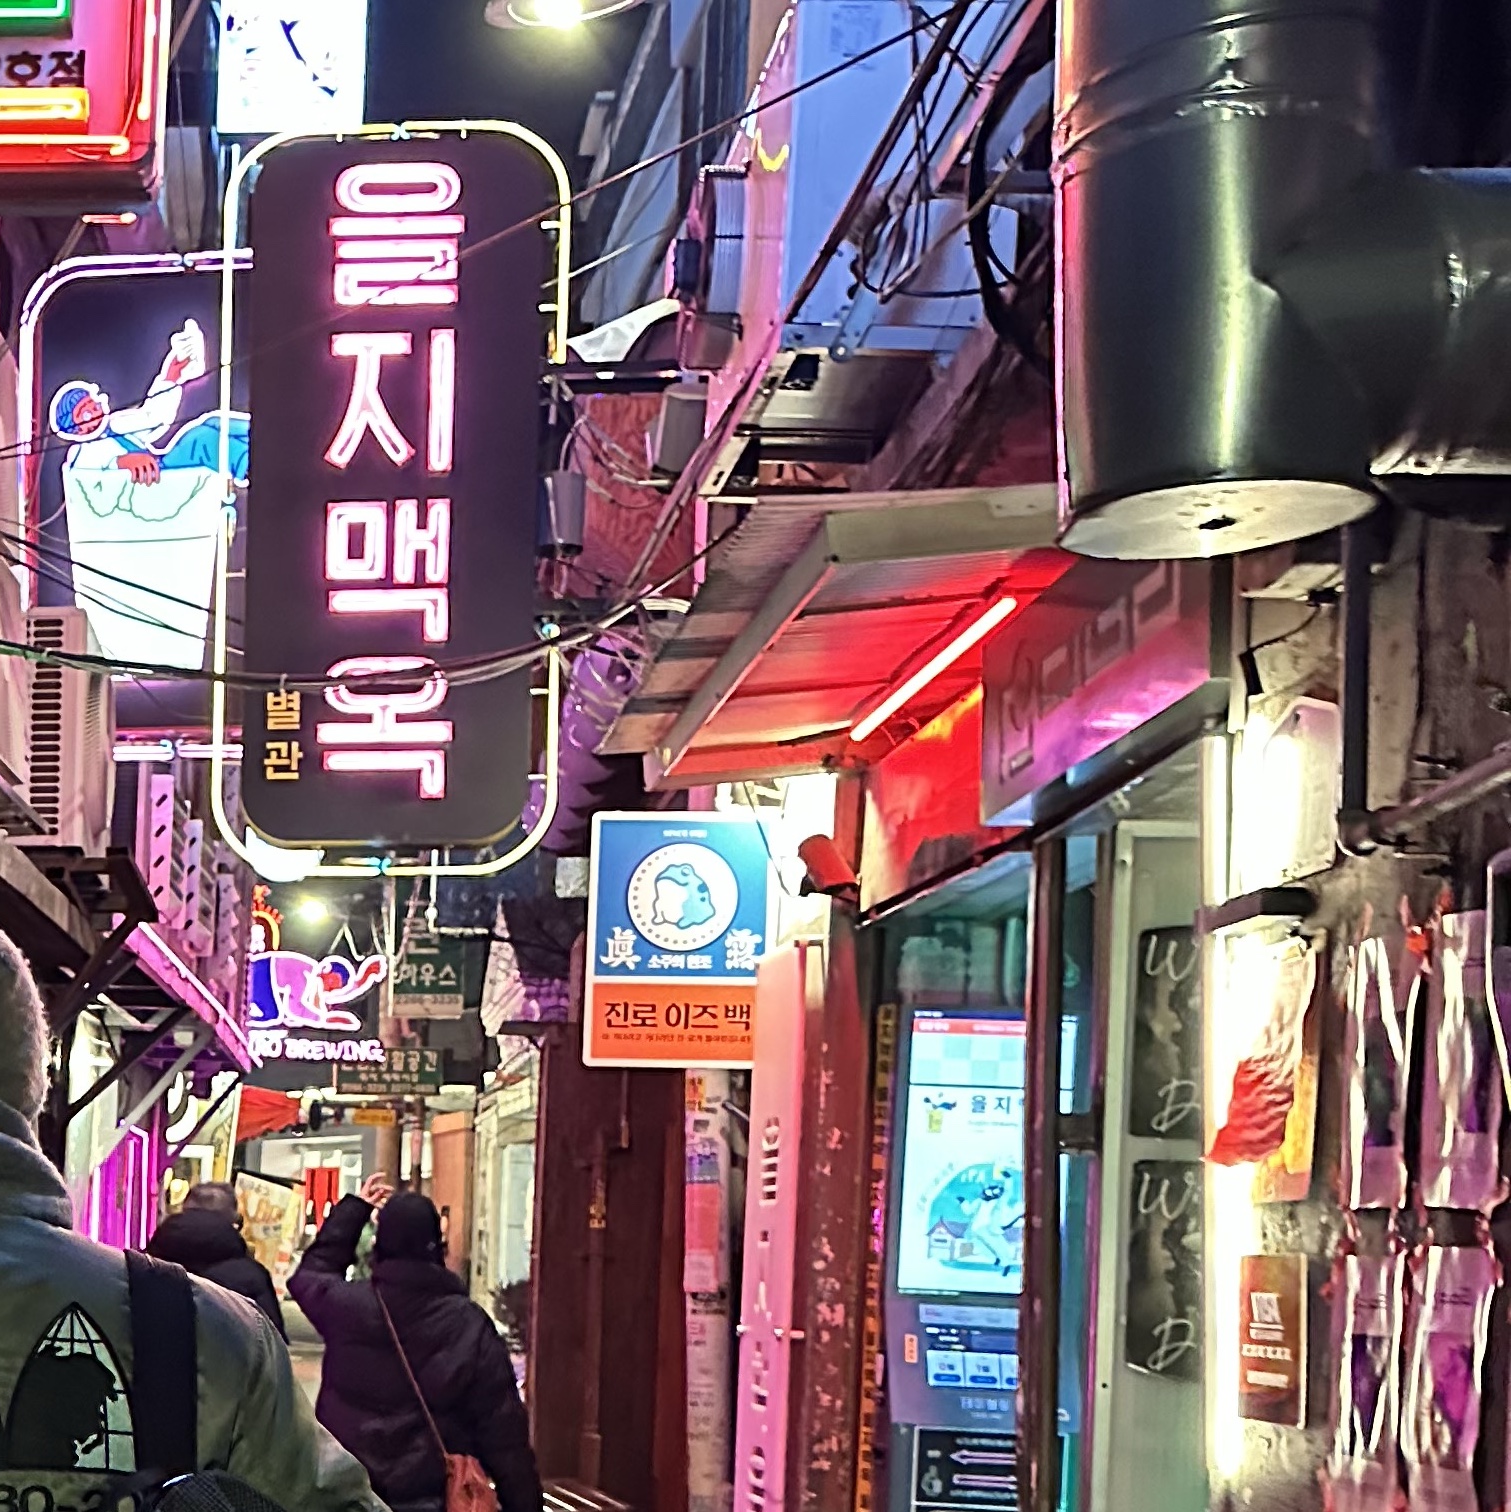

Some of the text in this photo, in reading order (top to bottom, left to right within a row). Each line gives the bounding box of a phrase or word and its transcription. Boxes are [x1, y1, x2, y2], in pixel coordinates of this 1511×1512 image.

[316, 160, 466, 800] 을지맥옥
[263, 689, 304, 780] 별관
[604, 1001, 751, 1031] 진로 이즈 백
